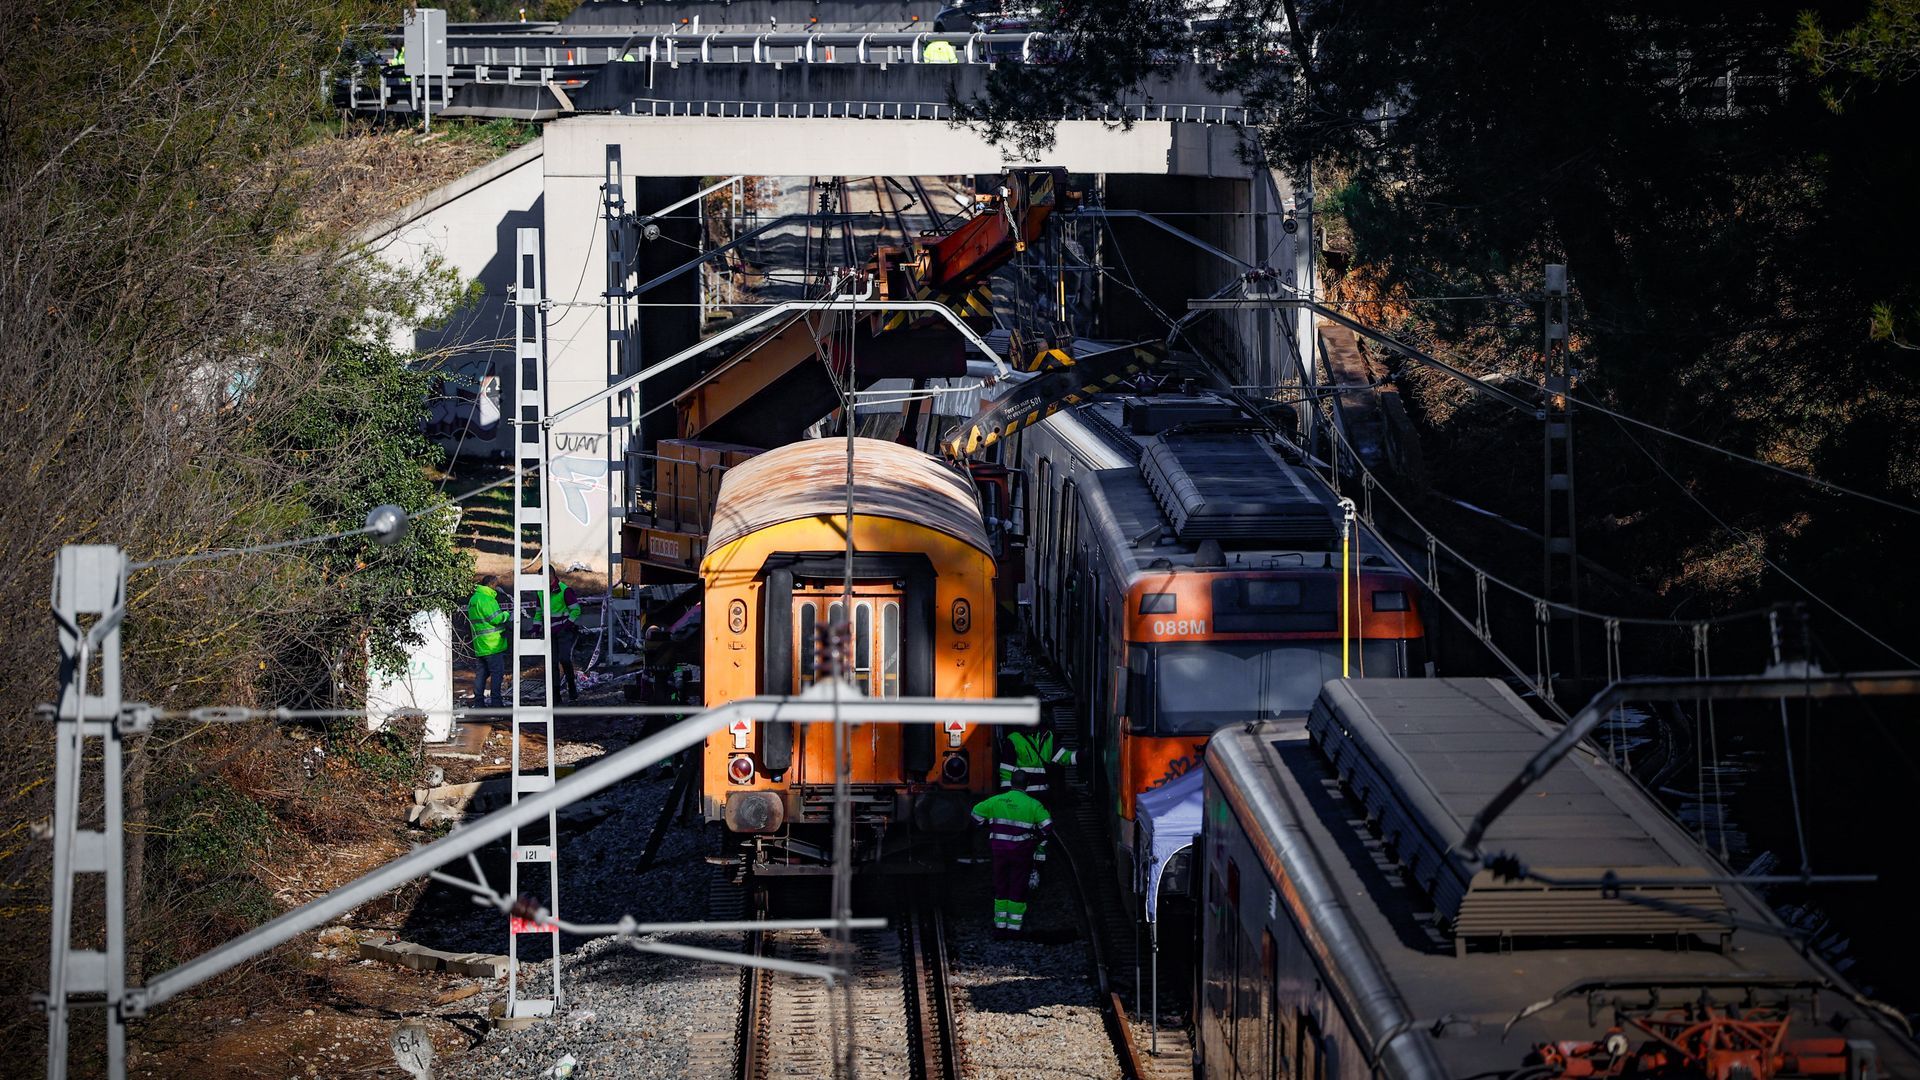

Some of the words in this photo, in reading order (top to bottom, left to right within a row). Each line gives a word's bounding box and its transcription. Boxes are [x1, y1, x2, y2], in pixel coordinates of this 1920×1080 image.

[1153, 620, 1206, 636] 088M
[525, 850, 537, 860] 121
[398, 1030, 420, 1053] 64
